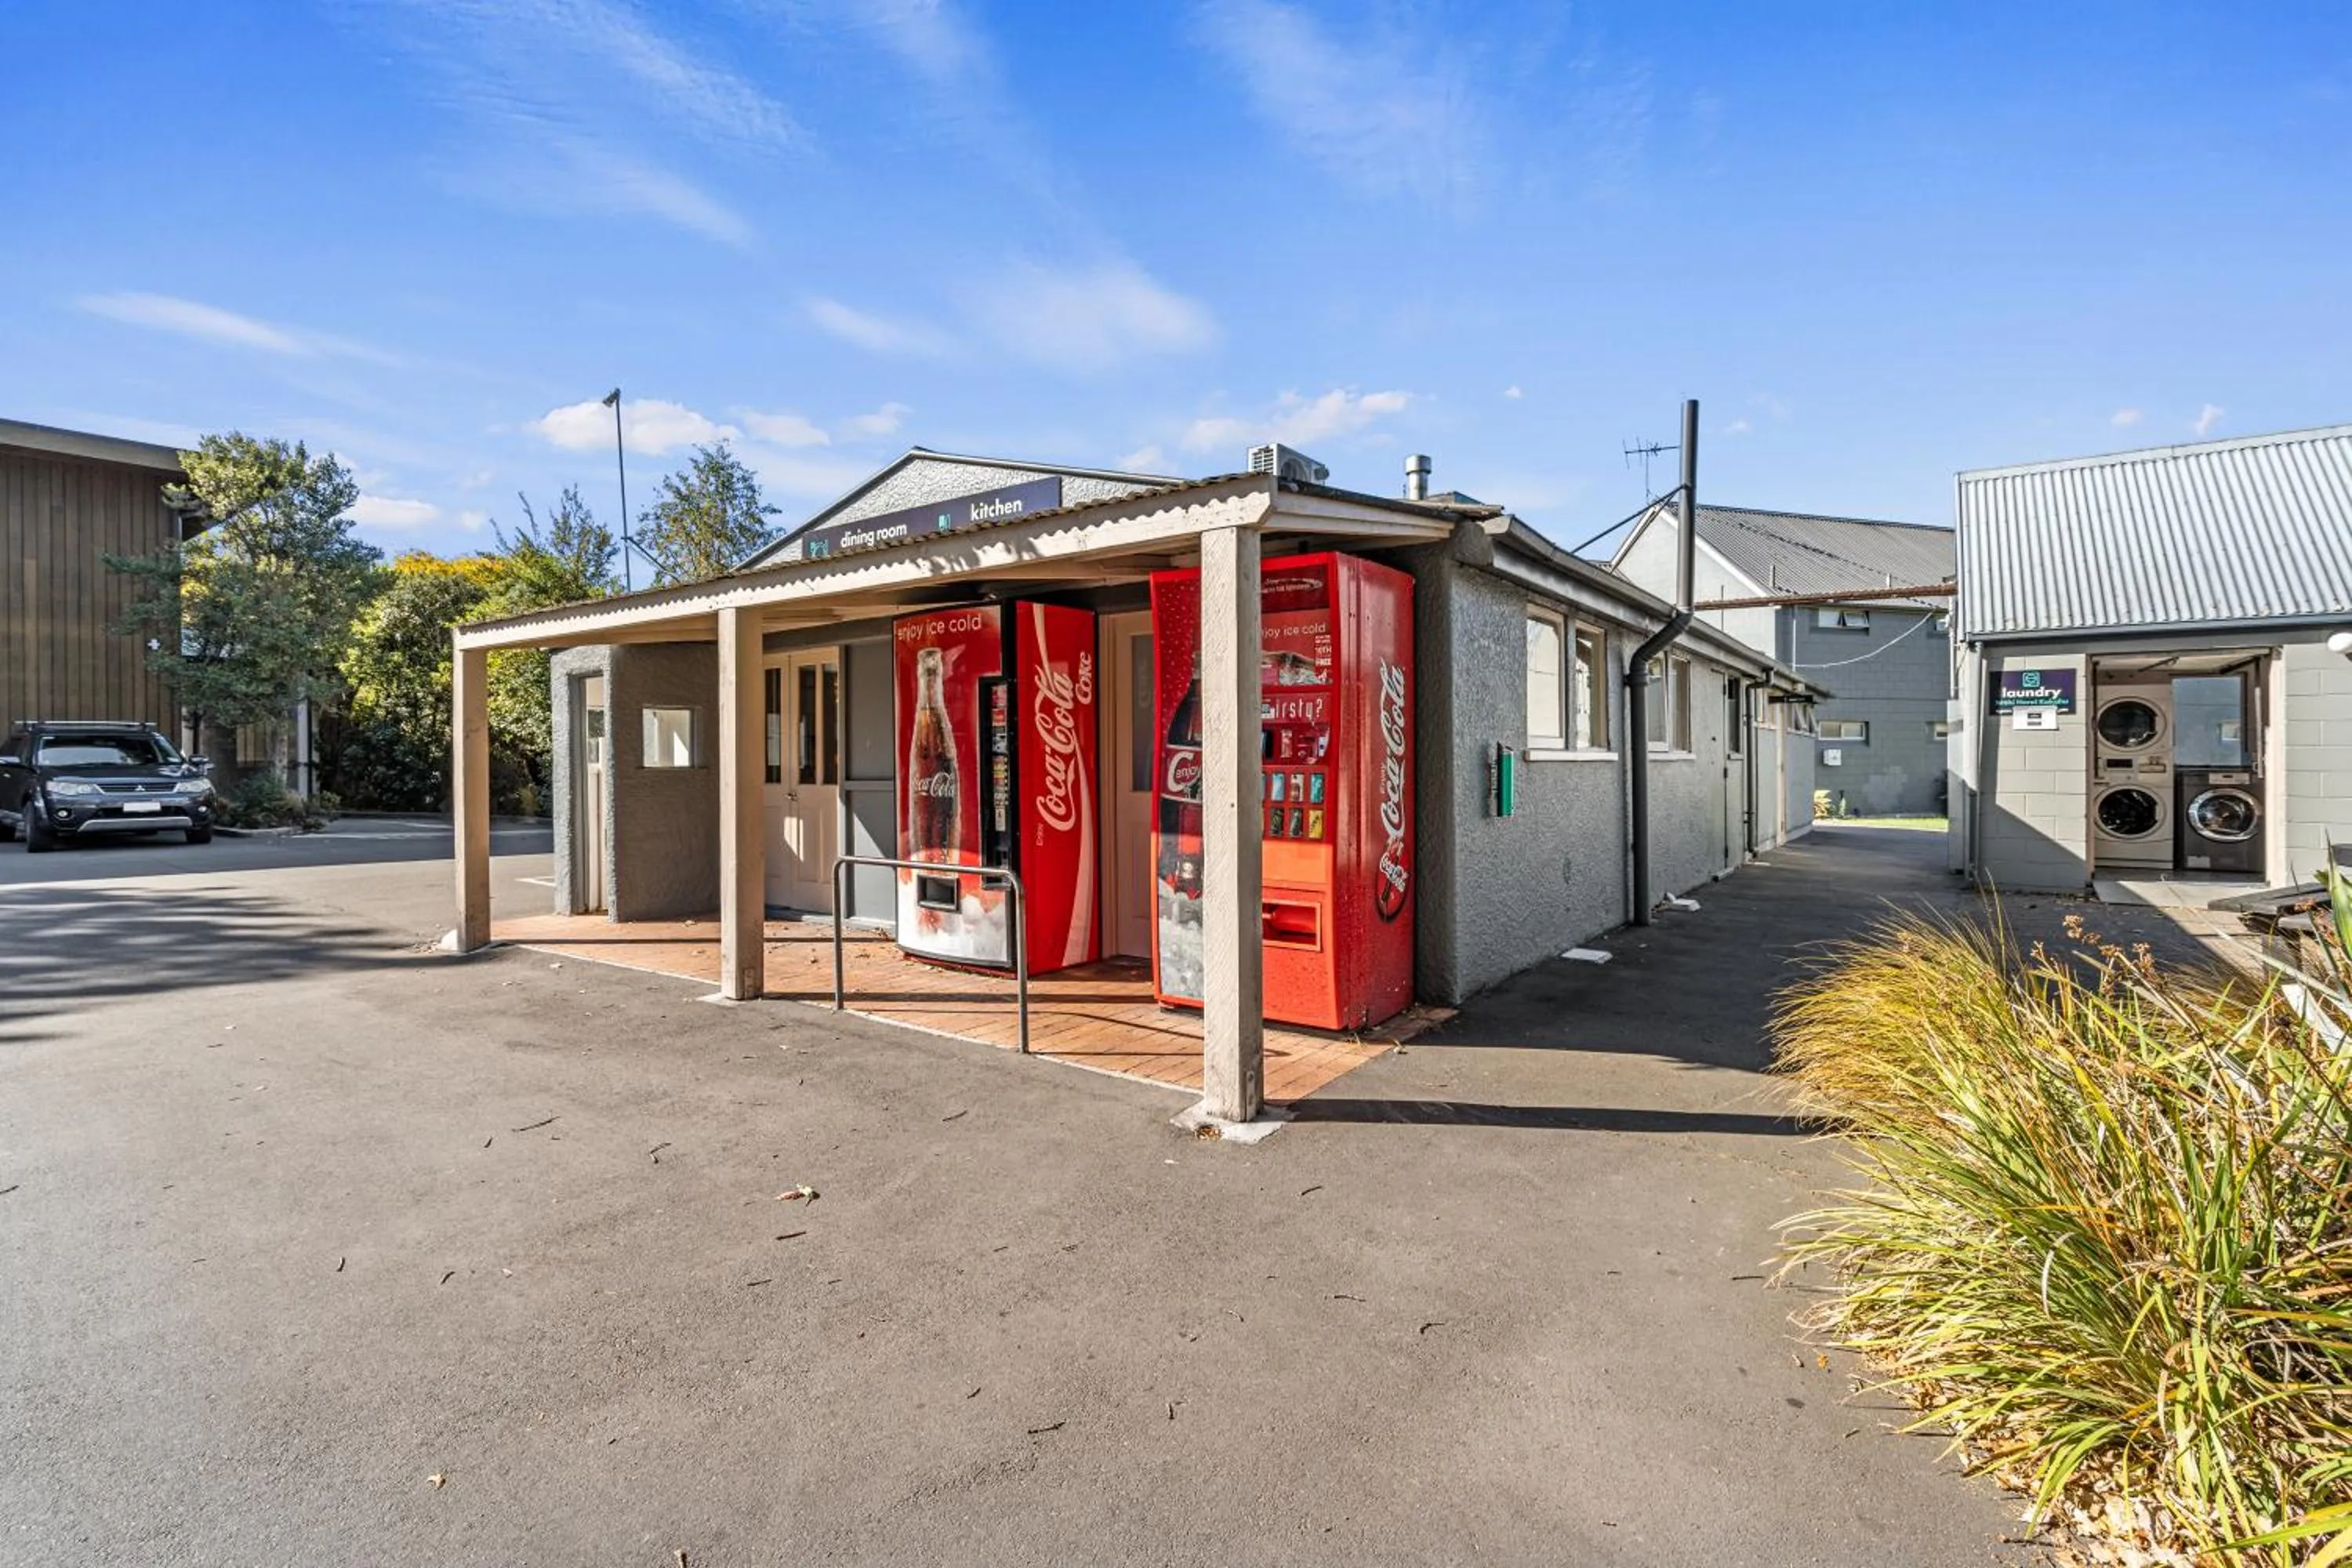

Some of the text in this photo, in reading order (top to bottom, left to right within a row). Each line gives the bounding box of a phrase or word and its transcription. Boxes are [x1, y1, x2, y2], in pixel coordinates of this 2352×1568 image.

[971, 498, 1022, 521] kitchen
[840, 524, 907, 546] dining room
[898, 612, 982, 641] enjoy ice cold
[1261, 622, 1326, 639] joy ice cold
[1076, 652, 1092, 705] Coke
[2002, 686, 2062, 699] laundry
[1261, 698, 1323, 727] irsty?
[1035, 663, 1076, 832] Coca-Cola
[1380, 657, 1406, 838] Coca-Cola
